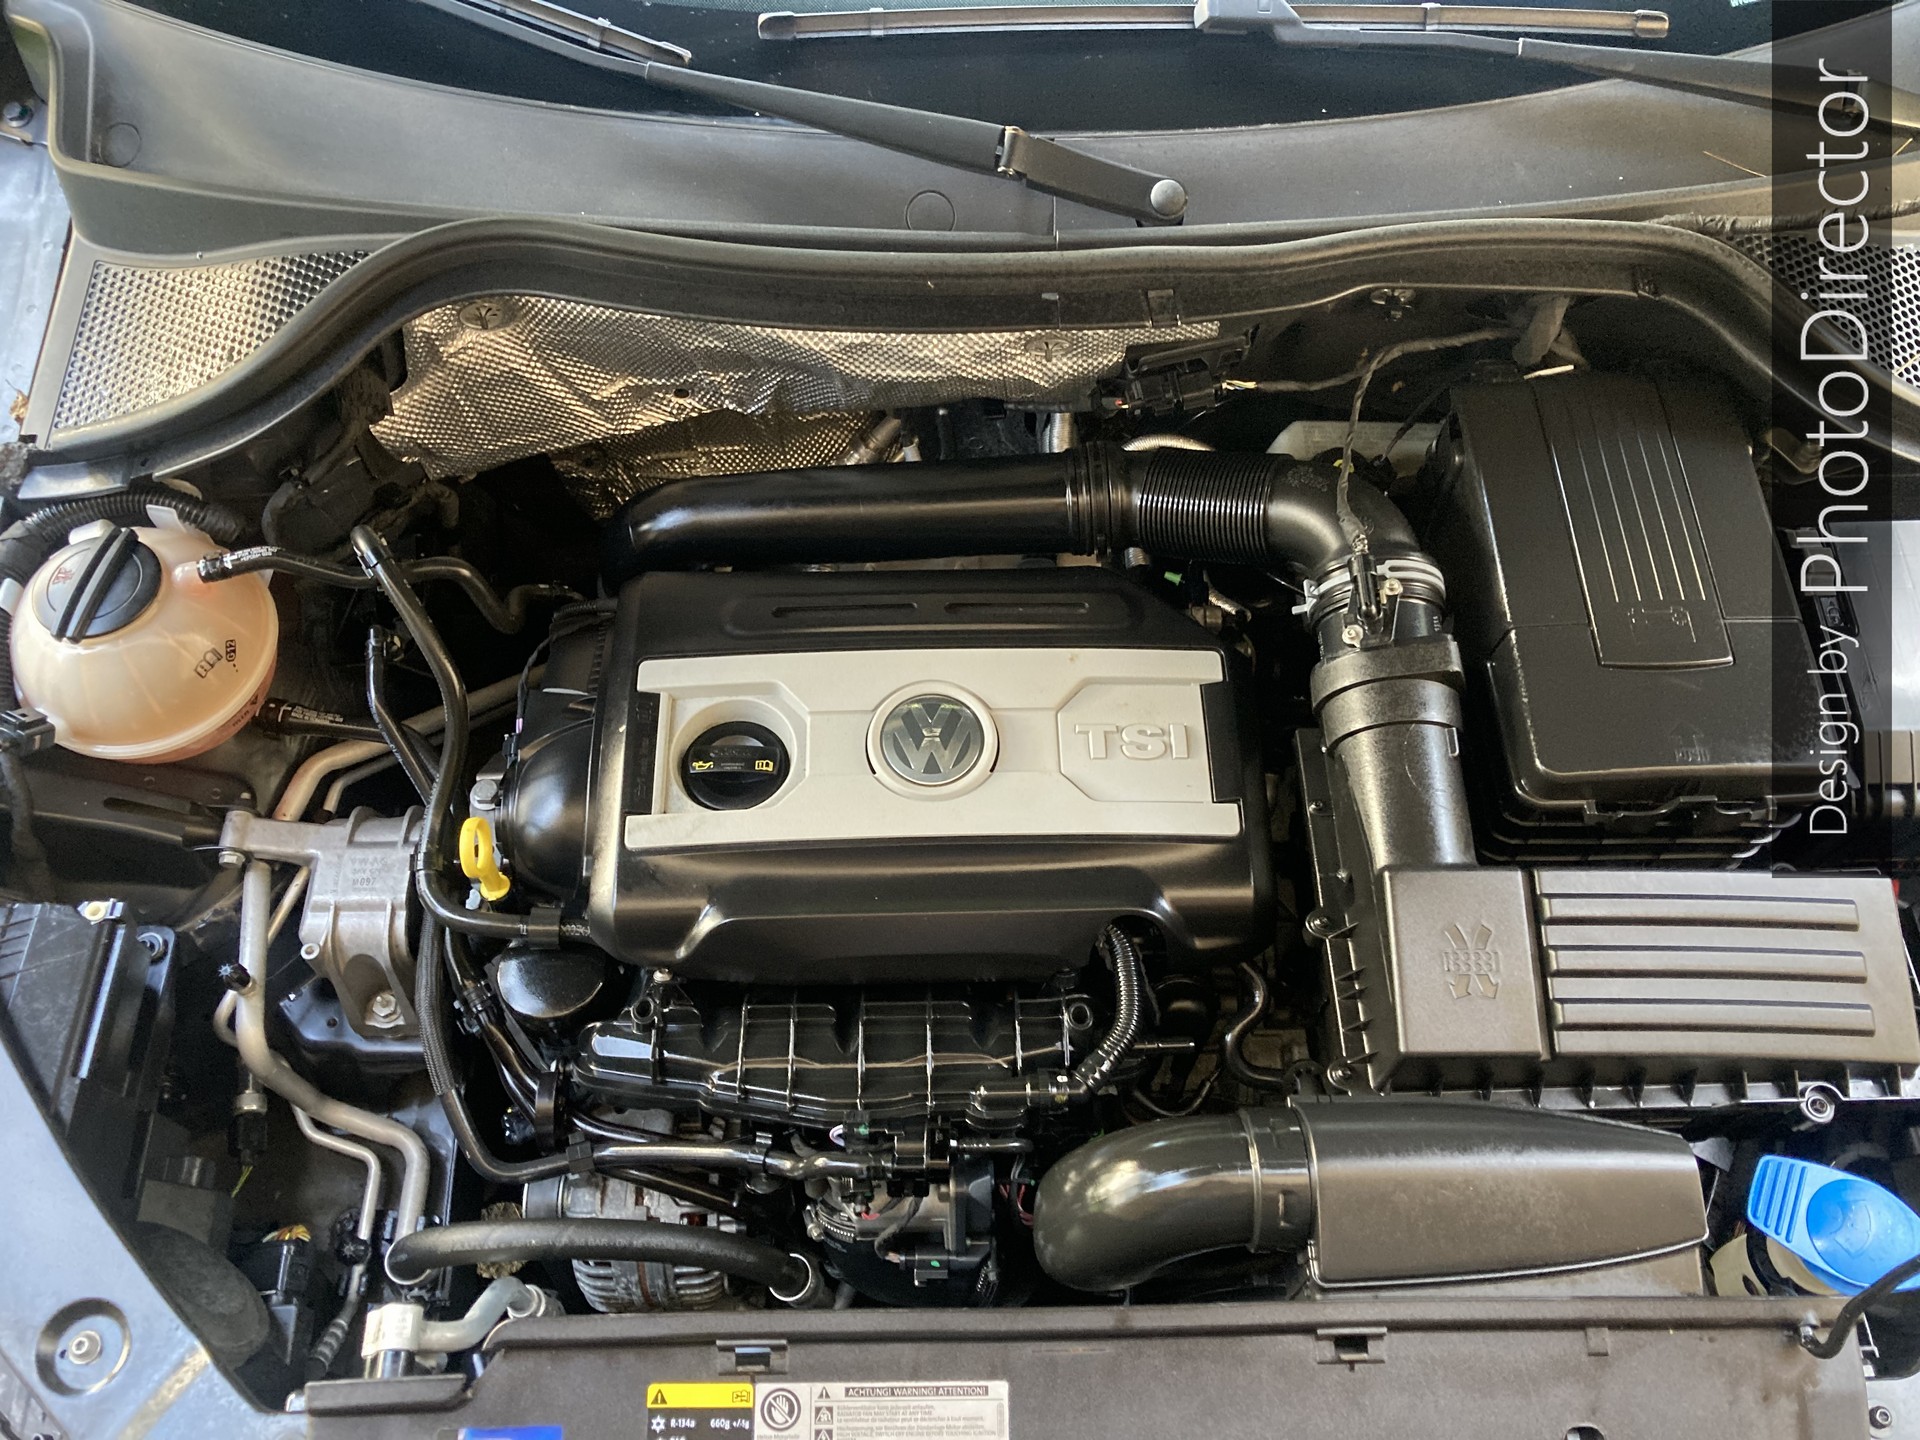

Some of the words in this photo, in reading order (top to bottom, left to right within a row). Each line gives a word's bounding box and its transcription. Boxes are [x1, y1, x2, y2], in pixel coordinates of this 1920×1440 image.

[226, 640, 236, 661] G12
[1075, 723, 1190, 760] TSI
[848, 1387, 891, 1397] ACHTUNG!
[893, 1387, 936, 1397] WARNING!
[938, 1386, 986, 1396] ATTENTION!
